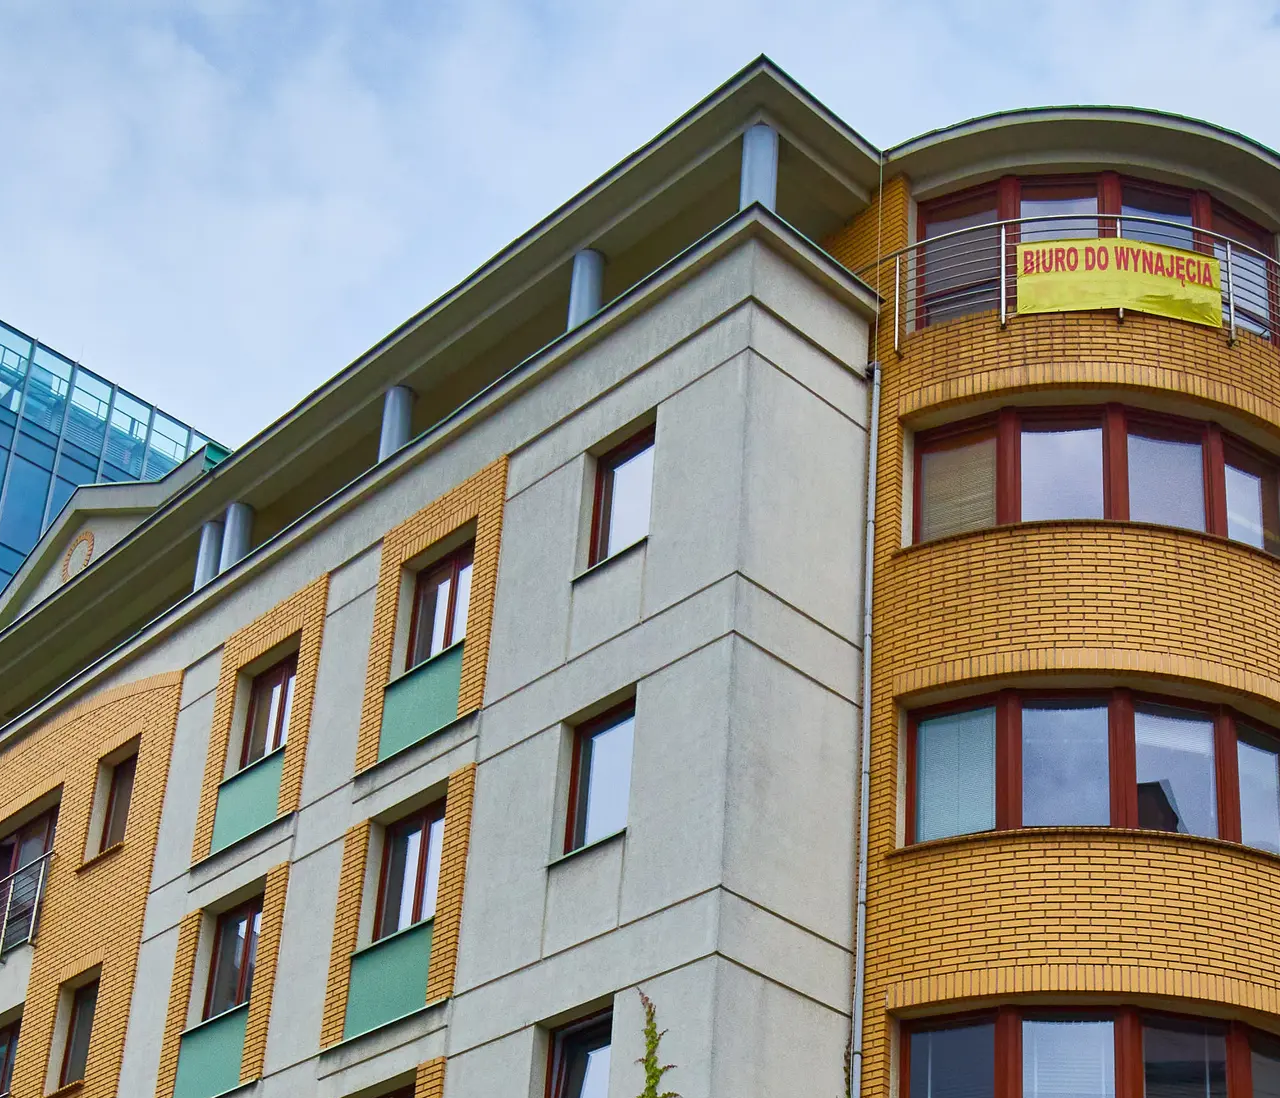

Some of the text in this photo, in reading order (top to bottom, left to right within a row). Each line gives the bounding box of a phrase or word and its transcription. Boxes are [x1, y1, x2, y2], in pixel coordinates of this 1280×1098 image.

[1023, 246, 1214, 288] BIURO DO WYNAJĘCIA
